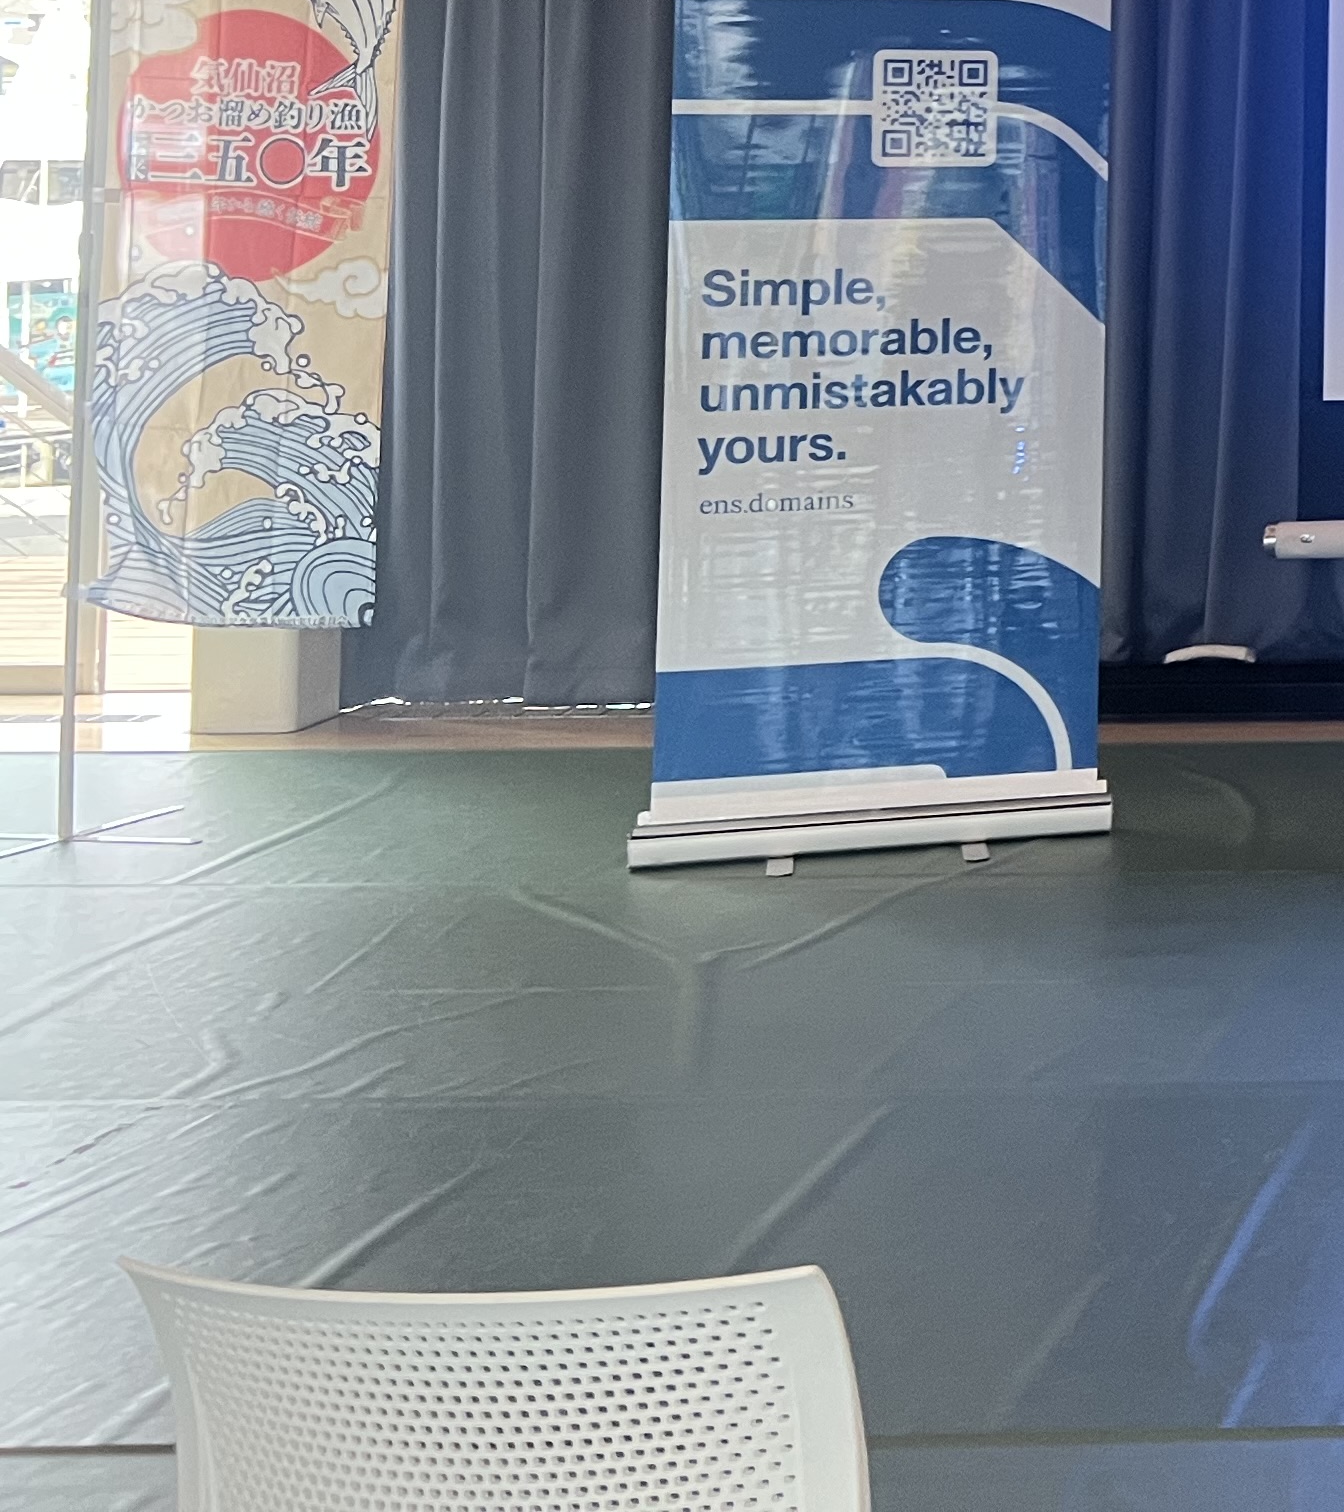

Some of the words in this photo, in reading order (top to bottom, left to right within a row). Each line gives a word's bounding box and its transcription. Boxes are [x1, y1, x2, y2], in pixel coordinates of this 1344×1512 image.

[191, 56, 301, 98] 気仙沼
[701, 267, 885, 317] Simple,
[701, 317, 993, 362] memorable,
[700, 367, 1025, 414] unmistakably
[697, 433, 846, 476] yours.
[699, 492, 854, 515] ens.domains
